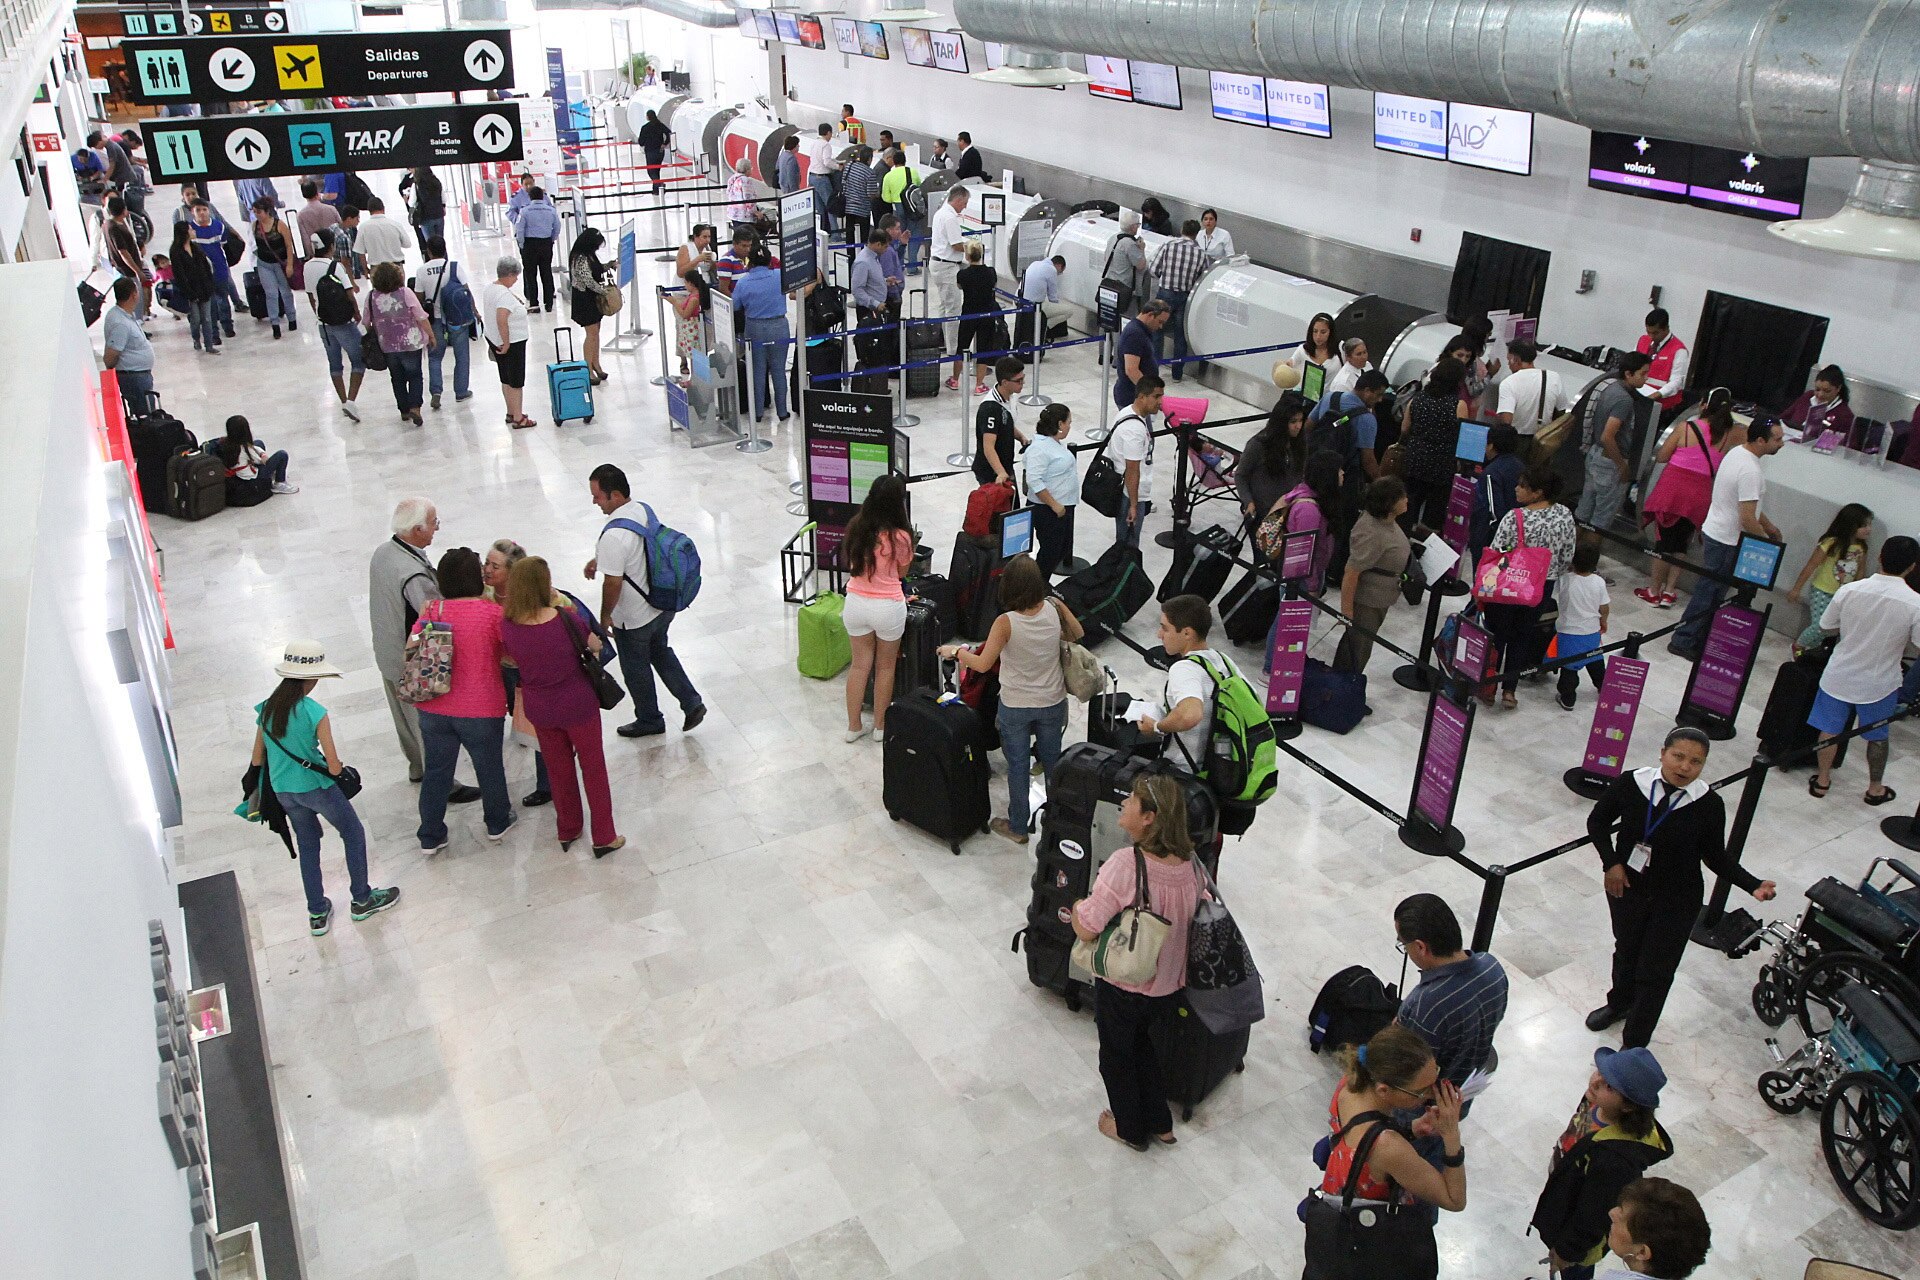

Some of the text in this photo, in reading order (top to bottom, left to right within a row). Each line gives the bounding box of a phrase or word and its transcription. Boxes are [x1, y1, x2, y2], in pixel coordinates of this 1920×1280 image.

[245, 14, 253, 24] B
[835, 27, 850, 43] TAR
[365, 49, 420, 62] Salidas
[933, 42, 954, 60] TAR
[368, 69, 429, 81] Departures
[1212, 81, 1250, 96] UNITED
[1268, 90, 1312, 105] UNITED
[1377, 106, 1427, 124] UNITED
[438, 121, 451, 135] B
[344, 129, 392, 151] TAR
[1624, 161, 1656, 175] volaris
[1728, 178, 1765, 194] volaris
[783, 201, 806, 214] UNITED
[821, 402, 858, 414] volaris
[987, 417, 995, 429] 5
[1643, 548, 1662, 560] volaris
[1304, 759, 1325, 775] volaris
[1382, 808, 1405, 827] volaris
